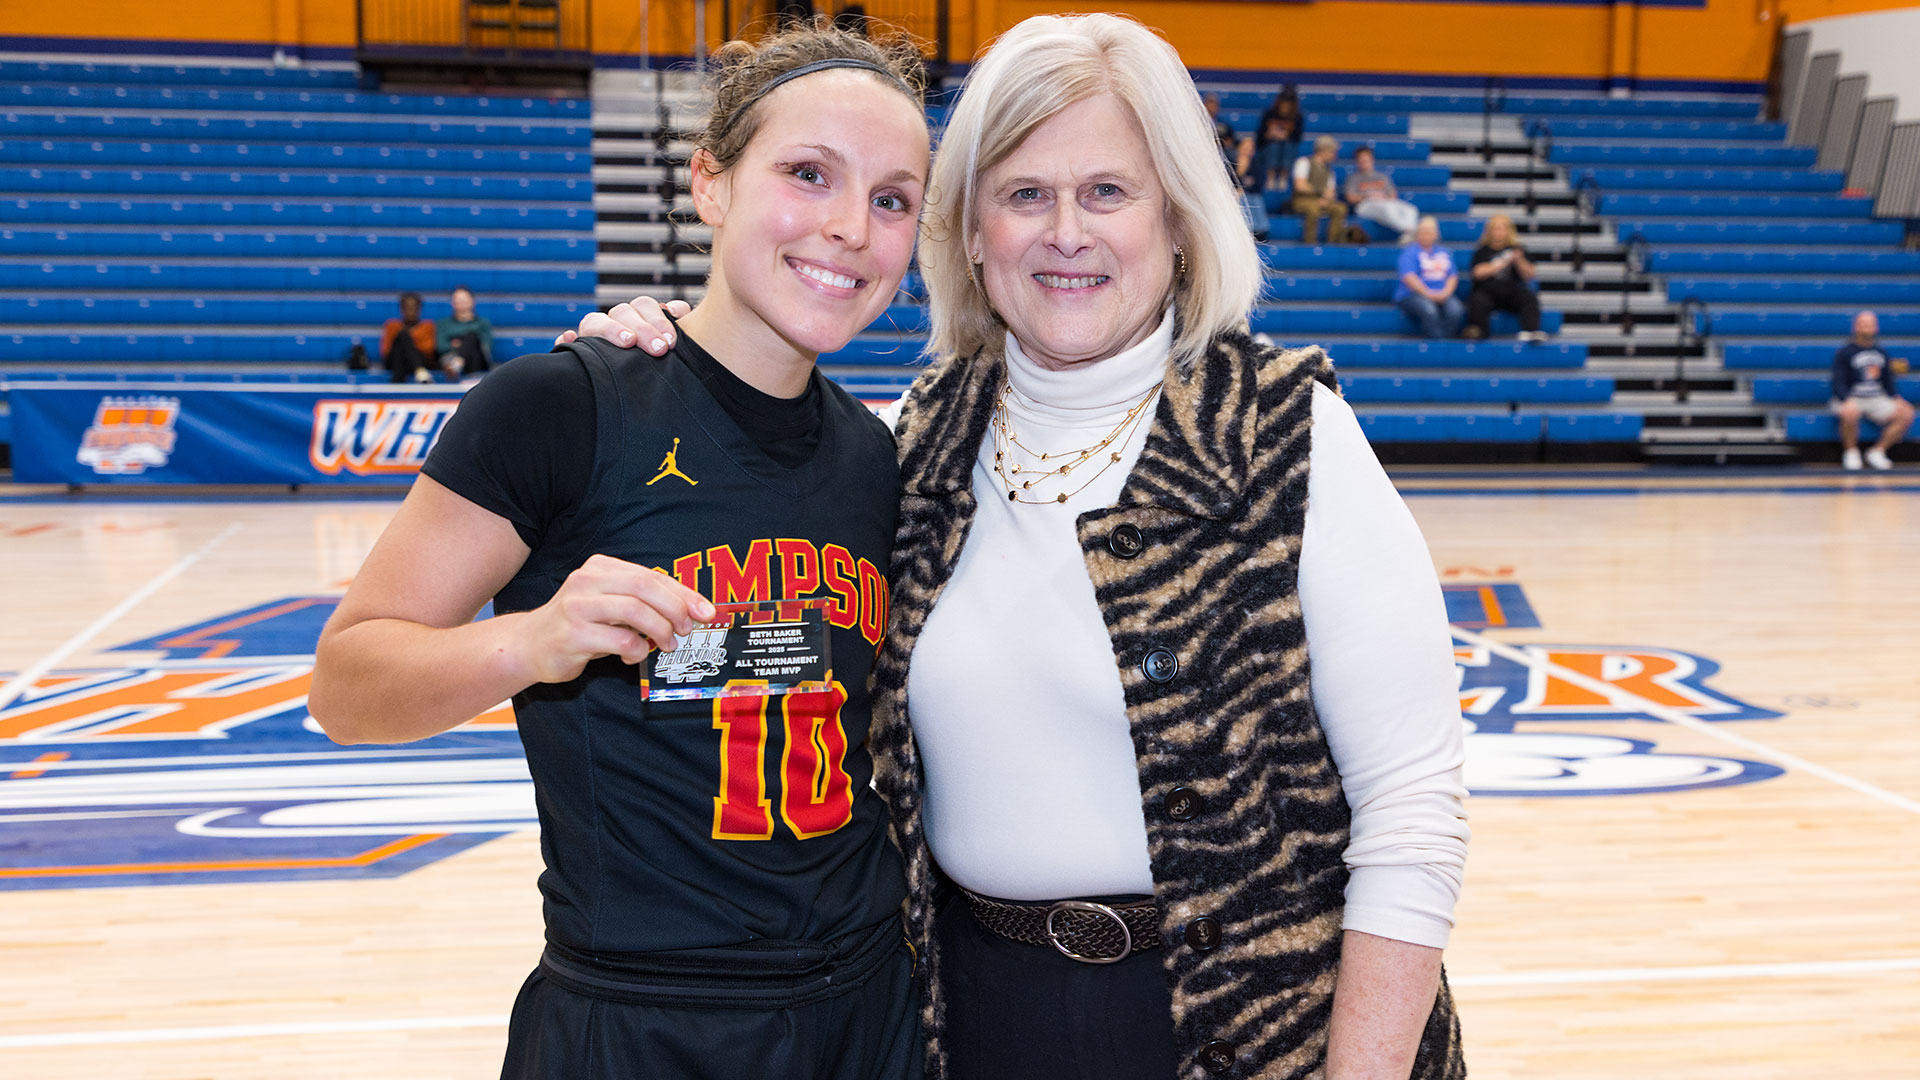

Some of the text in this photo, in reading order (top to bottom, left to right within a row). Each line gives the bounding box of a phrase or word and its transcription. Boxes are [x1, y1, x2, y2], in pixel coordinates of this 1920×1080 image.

[650, 538, 889, 656] IMPSO
[749, 629, 802, 639] BETH BAKER
[747, 637, 805, 646] TOURNAMENT
[655, 648, 727, 669] THUNDER
[735, 656, 819, 668] ALL TOURNAMENT
[753, 667, 802, 677] TEAM MVP
[711, 678, 854, 841] 10
